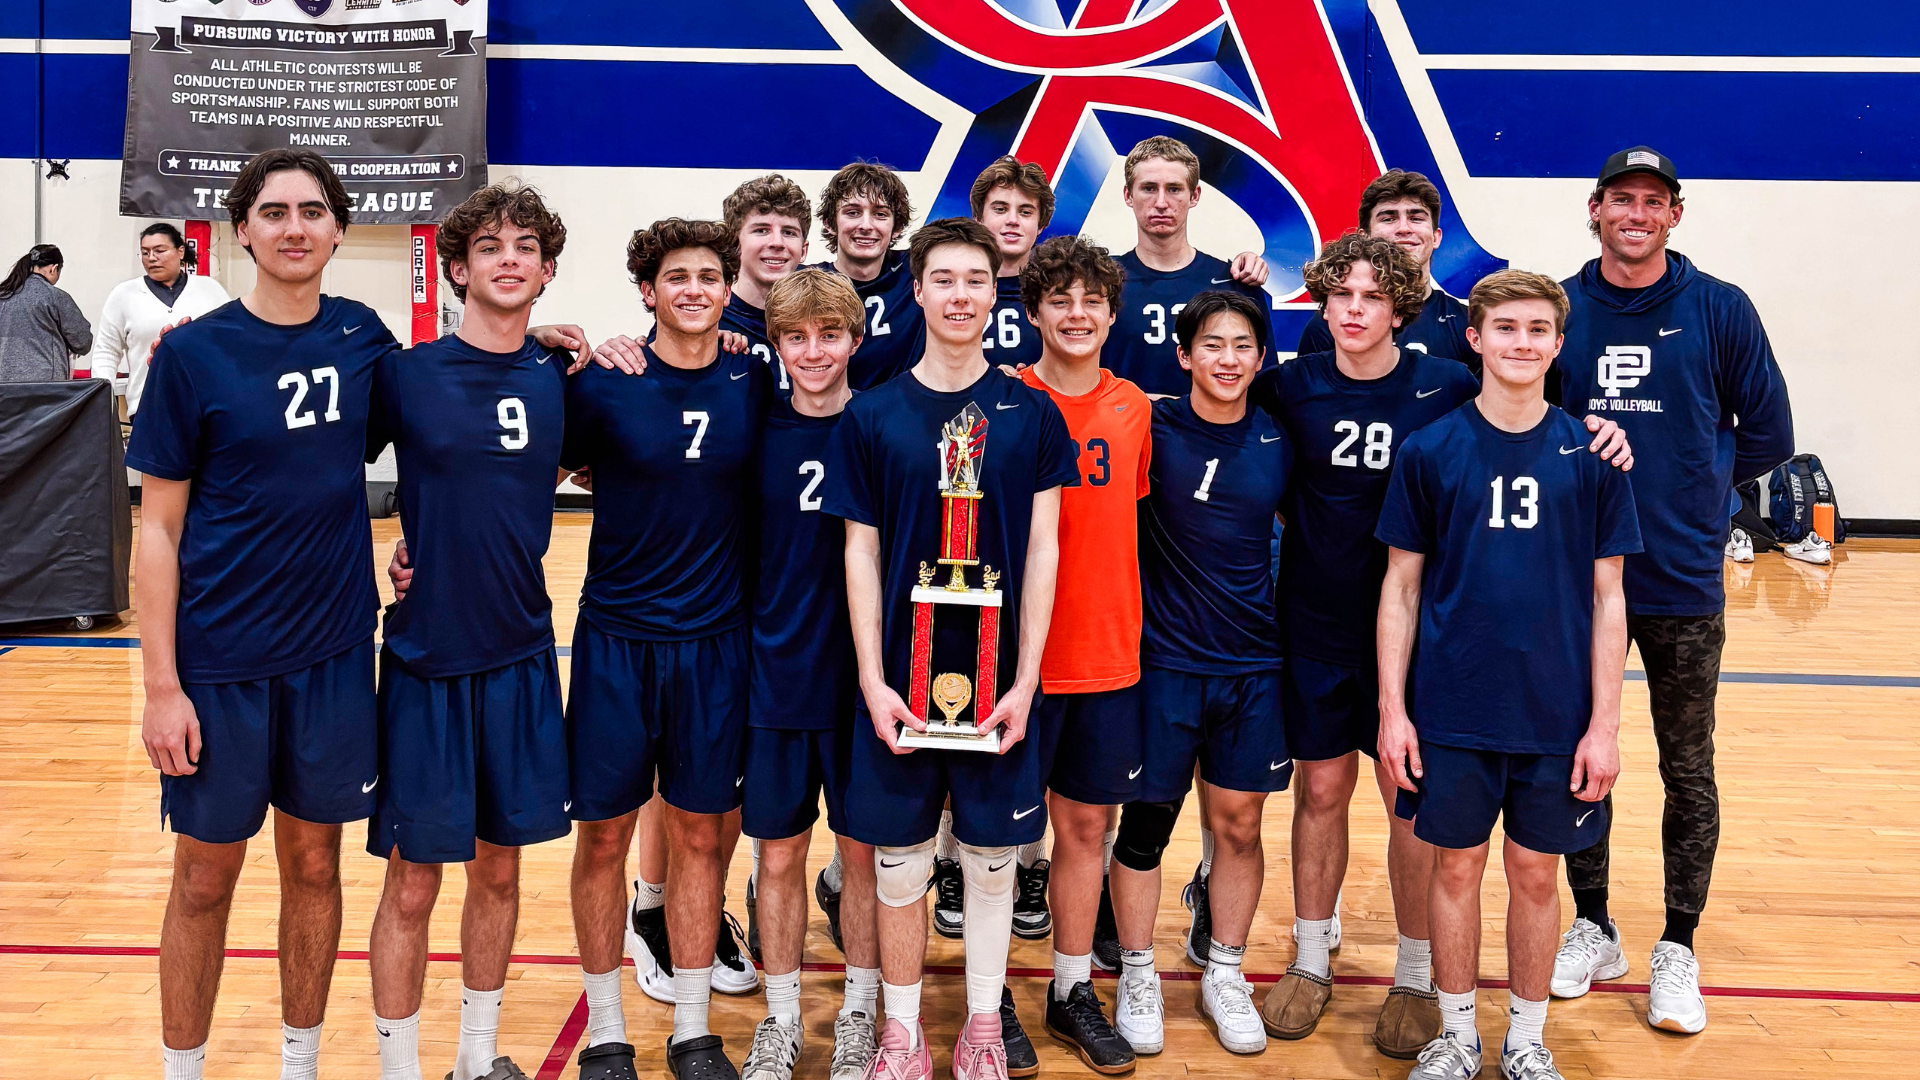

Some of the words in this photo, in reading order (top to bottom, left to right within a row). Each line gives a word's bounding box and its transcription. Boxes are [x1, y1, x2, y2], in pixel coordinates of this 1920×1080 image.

[193, 24, 272, 40] PURSUING
[276, 28, 349, 44] VICTORY
[351, 29, 390, 44] WITH
[392, 27, 436, 42] HONOR
[210, 58, 239, 71] ALL
[241, 60, 306, 74] ATHLETIC
[308, 62, 375, 75] CONTESTS
[376, 62, 408, 74] WILL
[409, 61, 423, 73] BE
[173, 74, 256, 90] CONDUCTED
[258, 78, 306, 92] UNDER
[308, 80, 336, 93] THE
[338, 80, 404, 93] STRICTEST
[406, 78, 438, 92] CODE
[440, 77, 458, 90] OF
[171, 91, 291, 109] SPORTSMANSHIP.
[294, 97, 331, 110] FANS
[333, 99, 366, 111] WILL
[367, 97, 422, 110] SUPPORT
[424, 96, 459, 109] BOTH
[189, 110, 238, 125] TEAMS
[240, 113, 253, 126] IN
[255, 114, 266, 126] A
[267, 114, 331, 128] POSITIVE
[333, 116, 362, 128] AND
[364, 115, 444, 128] RESPECTFUL
[289, 132, 351, 146] MANNER.
[188, 158, 242, 172] THANK
[350, 162, 441, 176] COOPERATION
[193, 187, 231, 208] TH
[347, 191, 434, 212] EAGUE
[413, 237, 424, 294] PORTER
[863, 295, 891, 337] 2
[277, 366, 341, 430] 27
[1610, 399, 1664, 413] VOLLEYBALL
[496, 397, 529, 450] 9
[682, 410, 710, 459] 7
[1331, 419, 1393, 470] 28
[798, 460, 825, 511] 2
[1193, 457, 1220, 502] 1
[1488, 475, 1539, 529] 13
